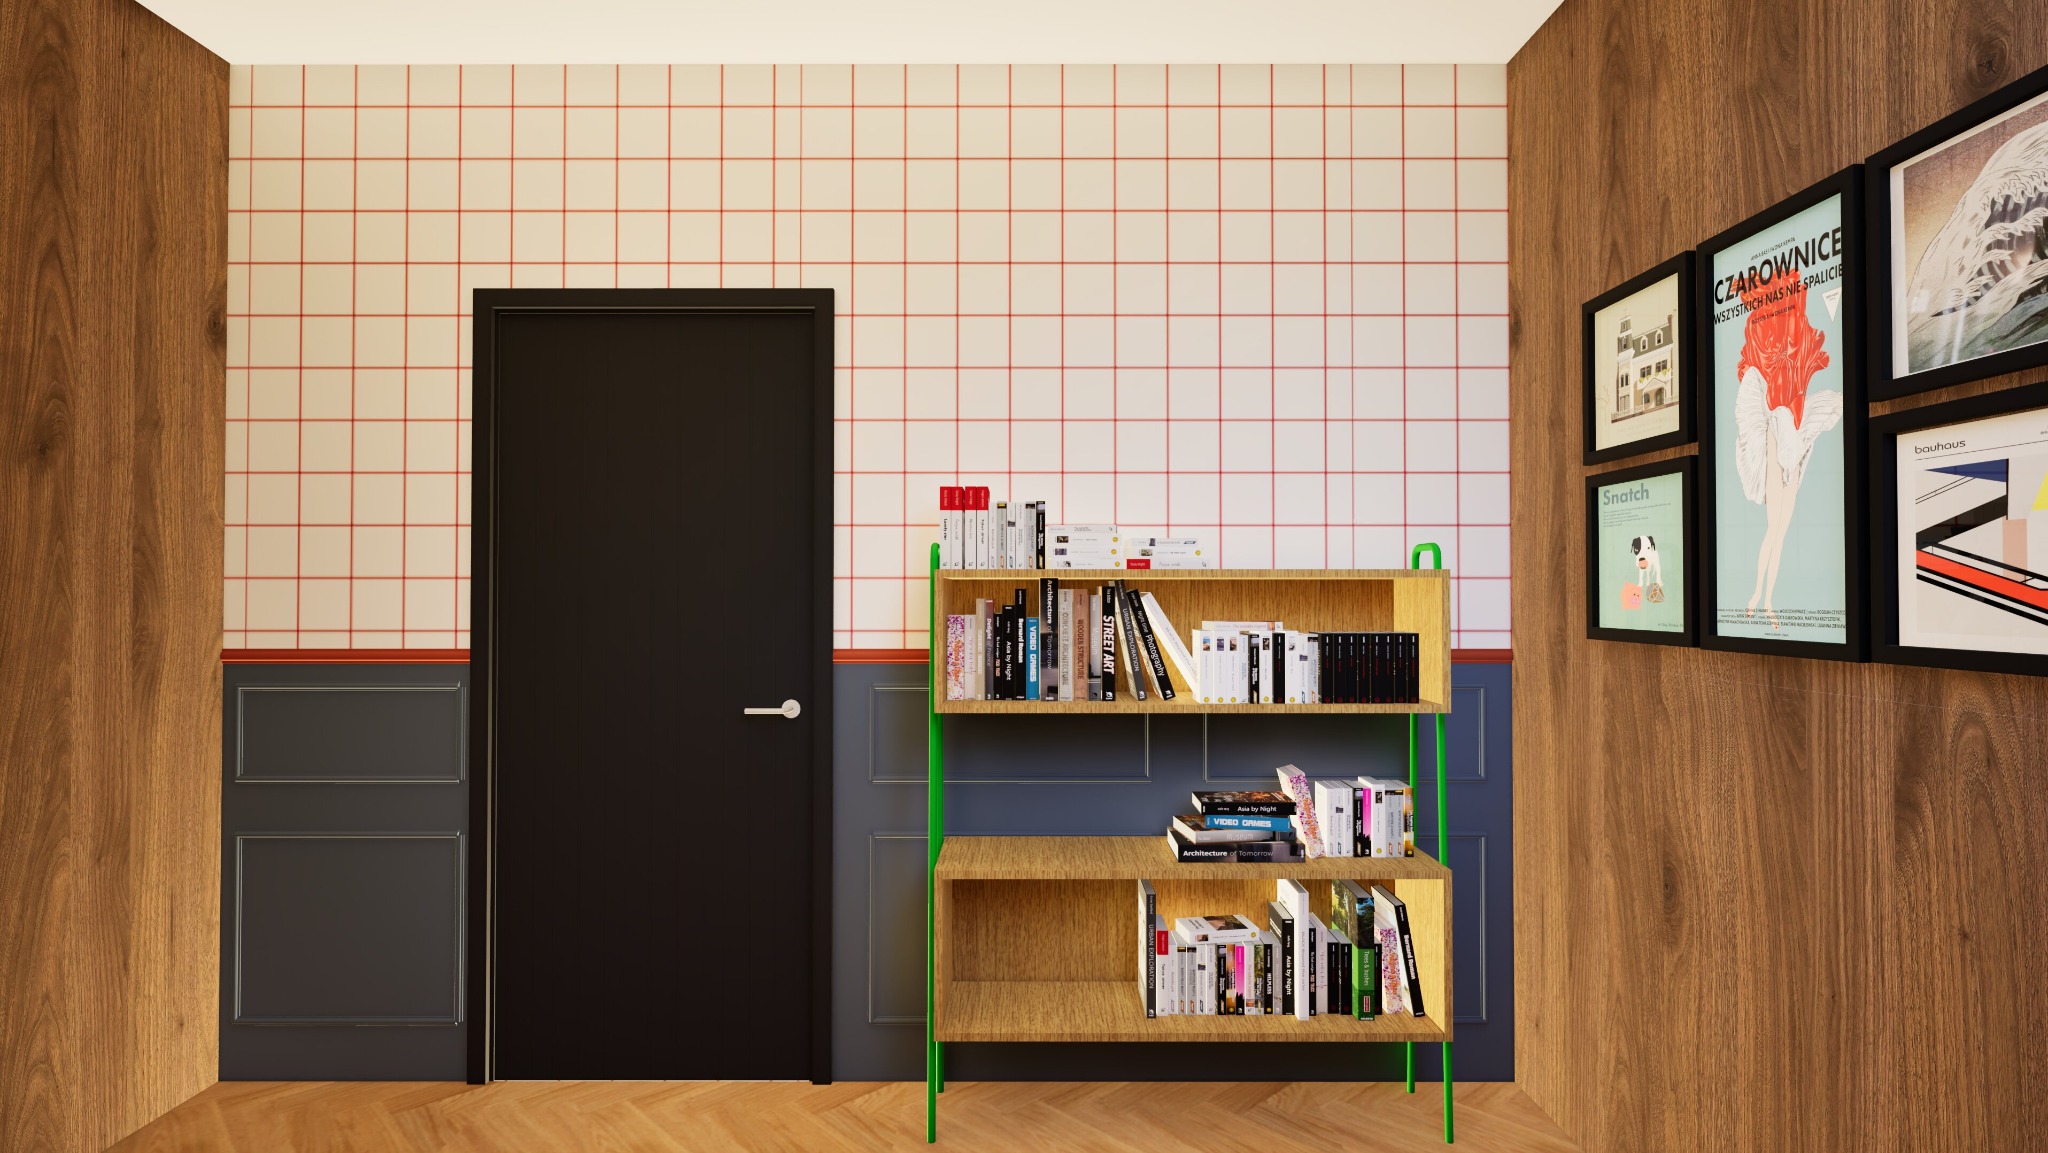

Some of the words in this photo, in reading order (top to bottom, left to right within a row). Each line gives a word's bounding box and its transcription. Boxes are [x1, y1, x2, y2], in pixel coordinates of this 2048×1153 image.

[1715, 227, 1841, 304] CZAROWNICE
[1714, 297, 1763, 325] WSZYSTKICH
[1766, 288, 1784, 306] NAS
[1786, 280, 1801, 296] NIE
[1804, 264, 1842, 290] SPALICIE
[1914, 440, 1966, 454] bauhaus
[1604, 483, 1650, 506] Snatch
[1103, 615, 1114, 653] STREET
[1122, 608, 1131, 630] URBAN
[1127, 631, 1140, 672] EXPLORATION
[1103, 654, 1114, 674] ART
[1146, 634, 1165, 676] Photography
[1404, 934, 1413, 958] Bernard
